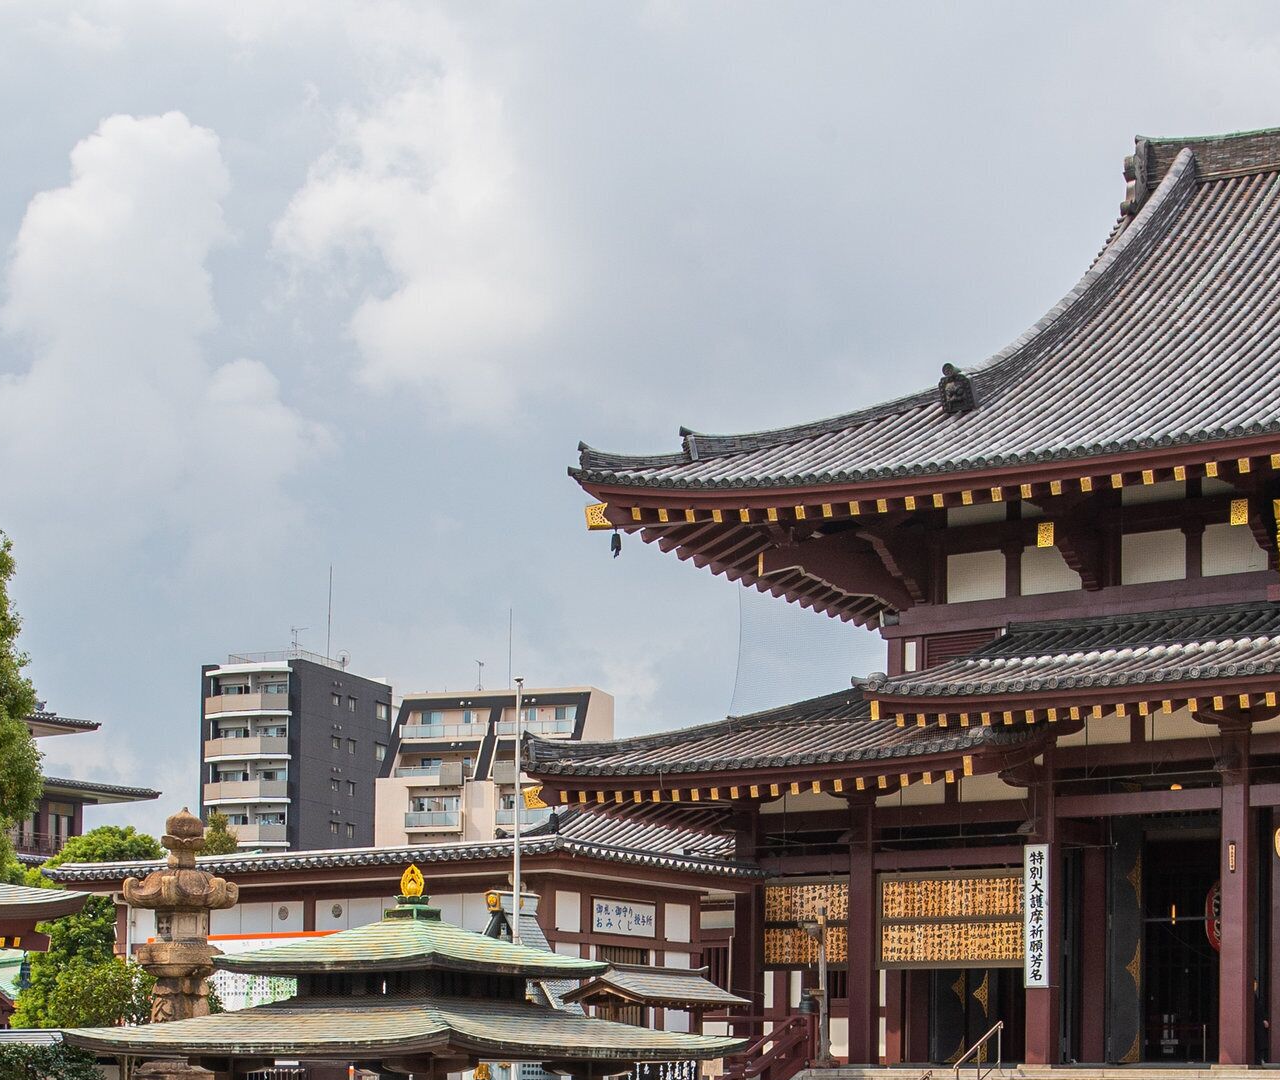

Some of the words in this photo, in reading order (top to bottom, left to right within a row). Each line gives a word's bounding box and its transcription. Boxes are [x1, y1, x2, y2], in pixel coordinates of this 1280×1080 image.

[596, 917, 633, 931] おみくじ
[1028, 851, 1045, 982] 特別大護摩祈願芳名
